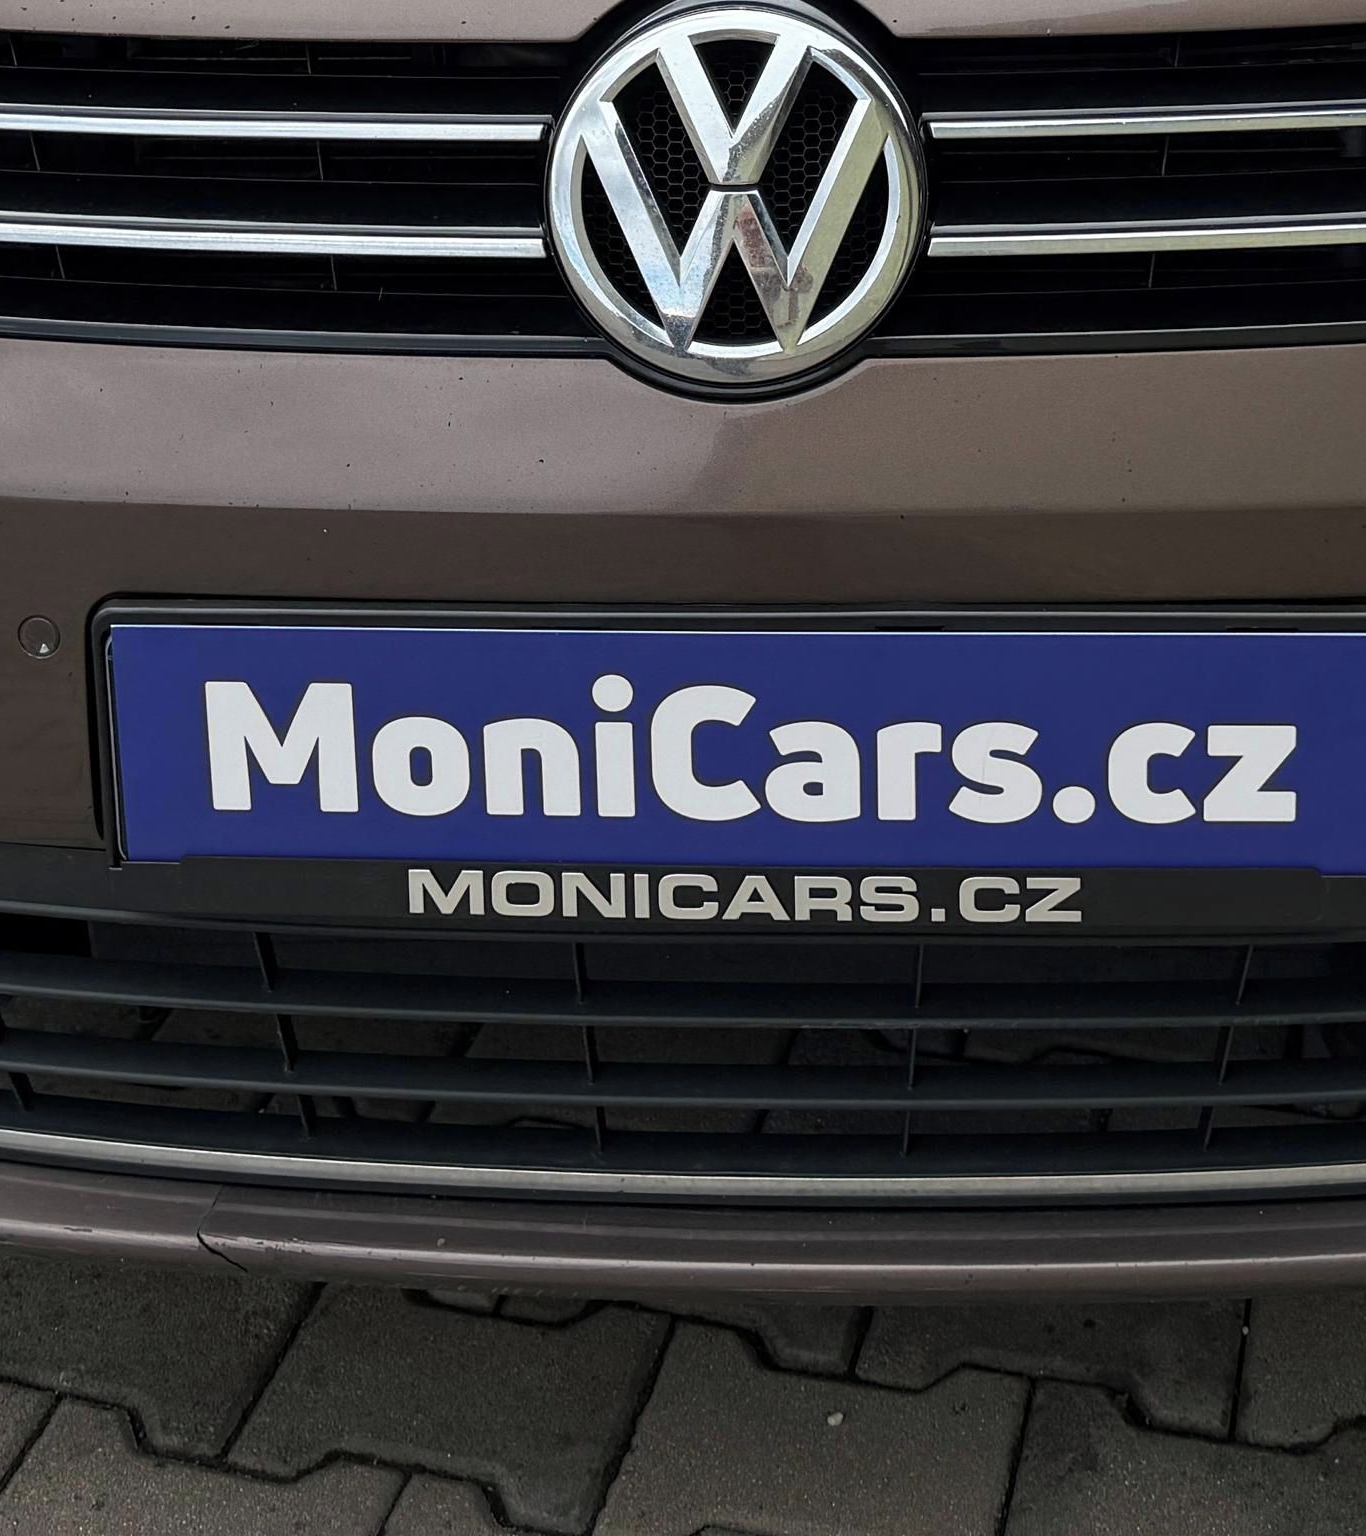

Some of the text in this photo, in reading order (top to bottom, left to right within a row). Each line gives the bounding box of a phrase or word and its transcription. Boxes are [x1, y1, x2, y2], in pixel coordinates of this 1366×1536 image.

[573, 26, 899, 357] VW
[205, 674, 1298, 825] MoniCars.cz
[407, 868, 1083, 923] MONICARS.CZ
